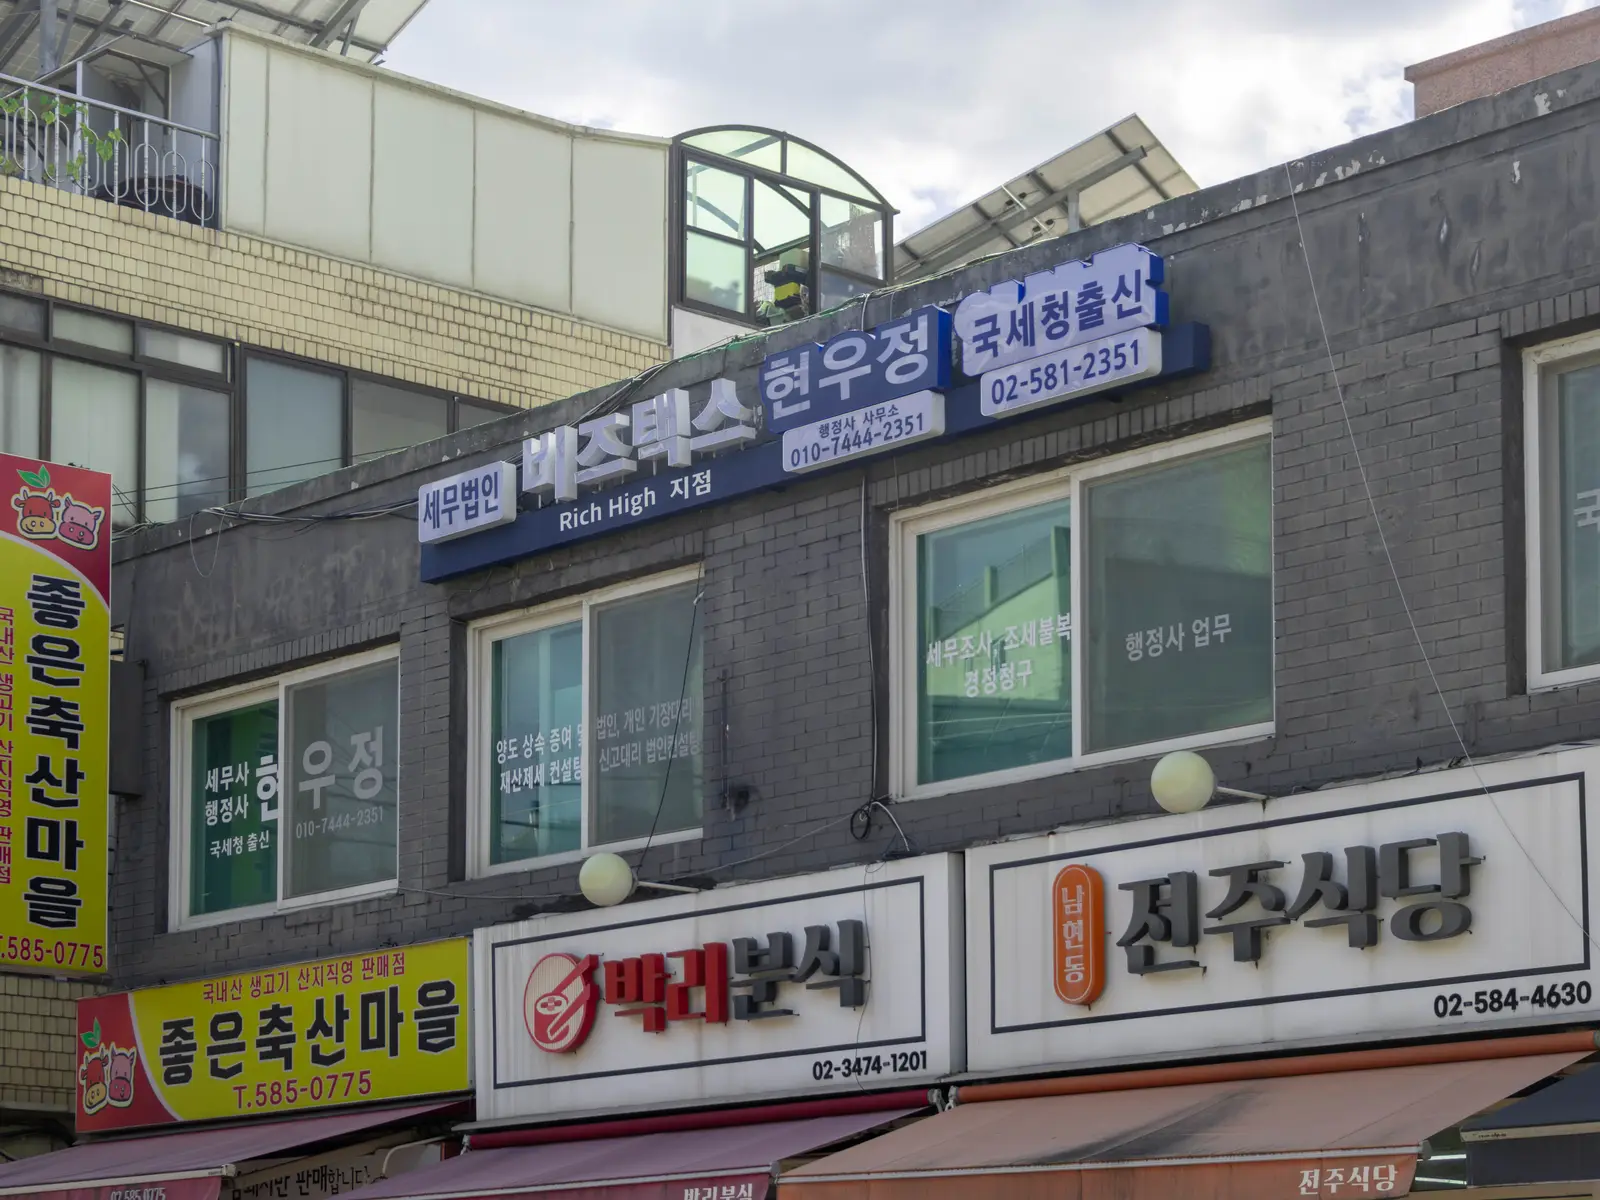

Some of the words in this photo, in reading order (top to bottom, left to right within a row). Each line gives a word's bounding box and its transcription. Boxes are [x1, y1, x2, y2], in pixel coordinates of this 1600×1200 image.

[972, 269, 1143, 357] 국세청출신
[763, 314, 929, 420] 현우정
[991, 340, 1140, 404] 02-581-2351
[790, 412, 923, 467] 010-7444-2351
[819, 416, 856, 439] 행정사
[863, 404, 899, 426] 사무소
[423, 471, 499, 530] 세무법인
[560, 506, 602, 532] Rich
[609, 486, 656, 519] High
[670, 469, 712, 499] 지점
[926, 629, 998, 668] 세무조사,
[1125, 622, 1185, 662] 행정사
[1192, 613, 1232, 648] 업무
[964, 659, 1033, 698] 경정청구
[623, 706, 646, 734] 개인
[24, 573, 86, 929] 좋은축산마을
[496, 737, 518, 765] 양도
[522, 731, 545, 760] 상속
[550, 724, 573, 753] 증여
[598, 741, 642, 772] 신고대리
[205, 761, 250, 793] 세무사
[204, 793, 249, 826] 행정사
[295, 805, 384, 839] 010-7444-2351
[209, 836, 244, 859] 국세청
[246, 830, 270, 852] 출신
[1116, 831, 1487, 976] 전주식당
[0, 936, 104, 969] .585-0775
[203, 981, 242, 1004] 국내산
[250, 971, 289, 999] 생고기
[297, 960, 353, 991] 산지직영
[361, 952, 405, 981] 판매점
[603, 918, 866, 1034] 박리분식
[1433, 980, 1592, 1019] 02-584-4630
[158, 979, 460, 1087] 좋은축산마을
[812, 1051, 928, 1081] 02-3474-1201
[232, 1069, 371, 1109] T.585-0775
[1298, 1164, 1398, 1195] 전주식당
